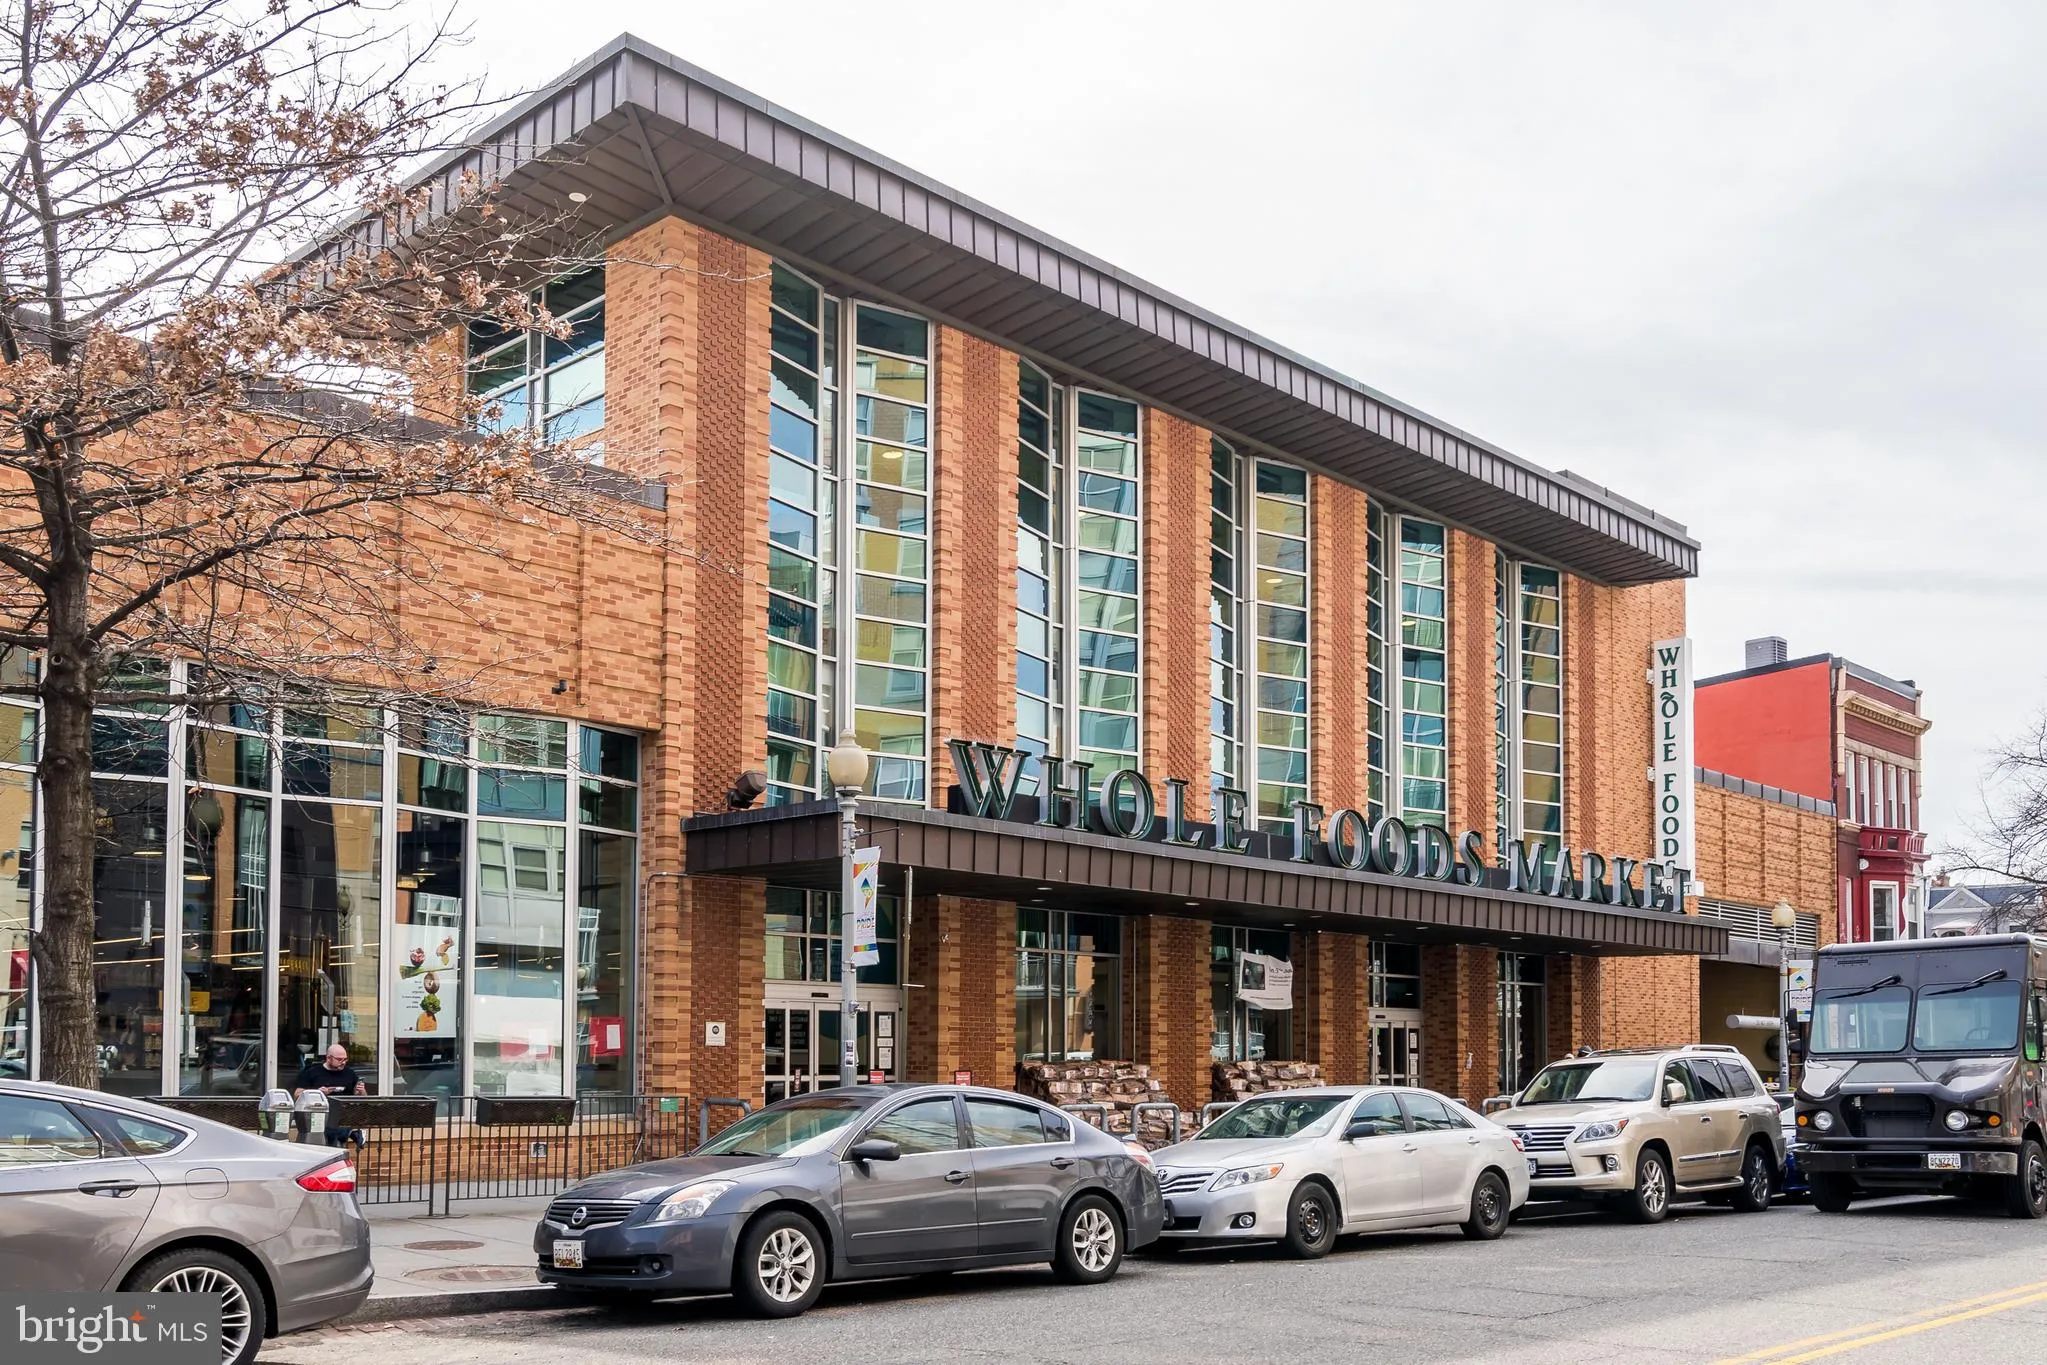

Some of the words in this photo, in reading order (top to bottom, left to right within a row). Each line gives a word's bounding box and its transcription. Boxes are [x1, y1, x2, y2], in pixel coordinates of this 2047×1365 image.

[1657, 646, 1681, 762] WHOLE
[943, 738, 1251, 854] WHOLE
[1289, 800, 1485, 887] FOODS
[1507, 838, 1692, 914] MARKET
[856, 918, 875, 929] PRIDE
